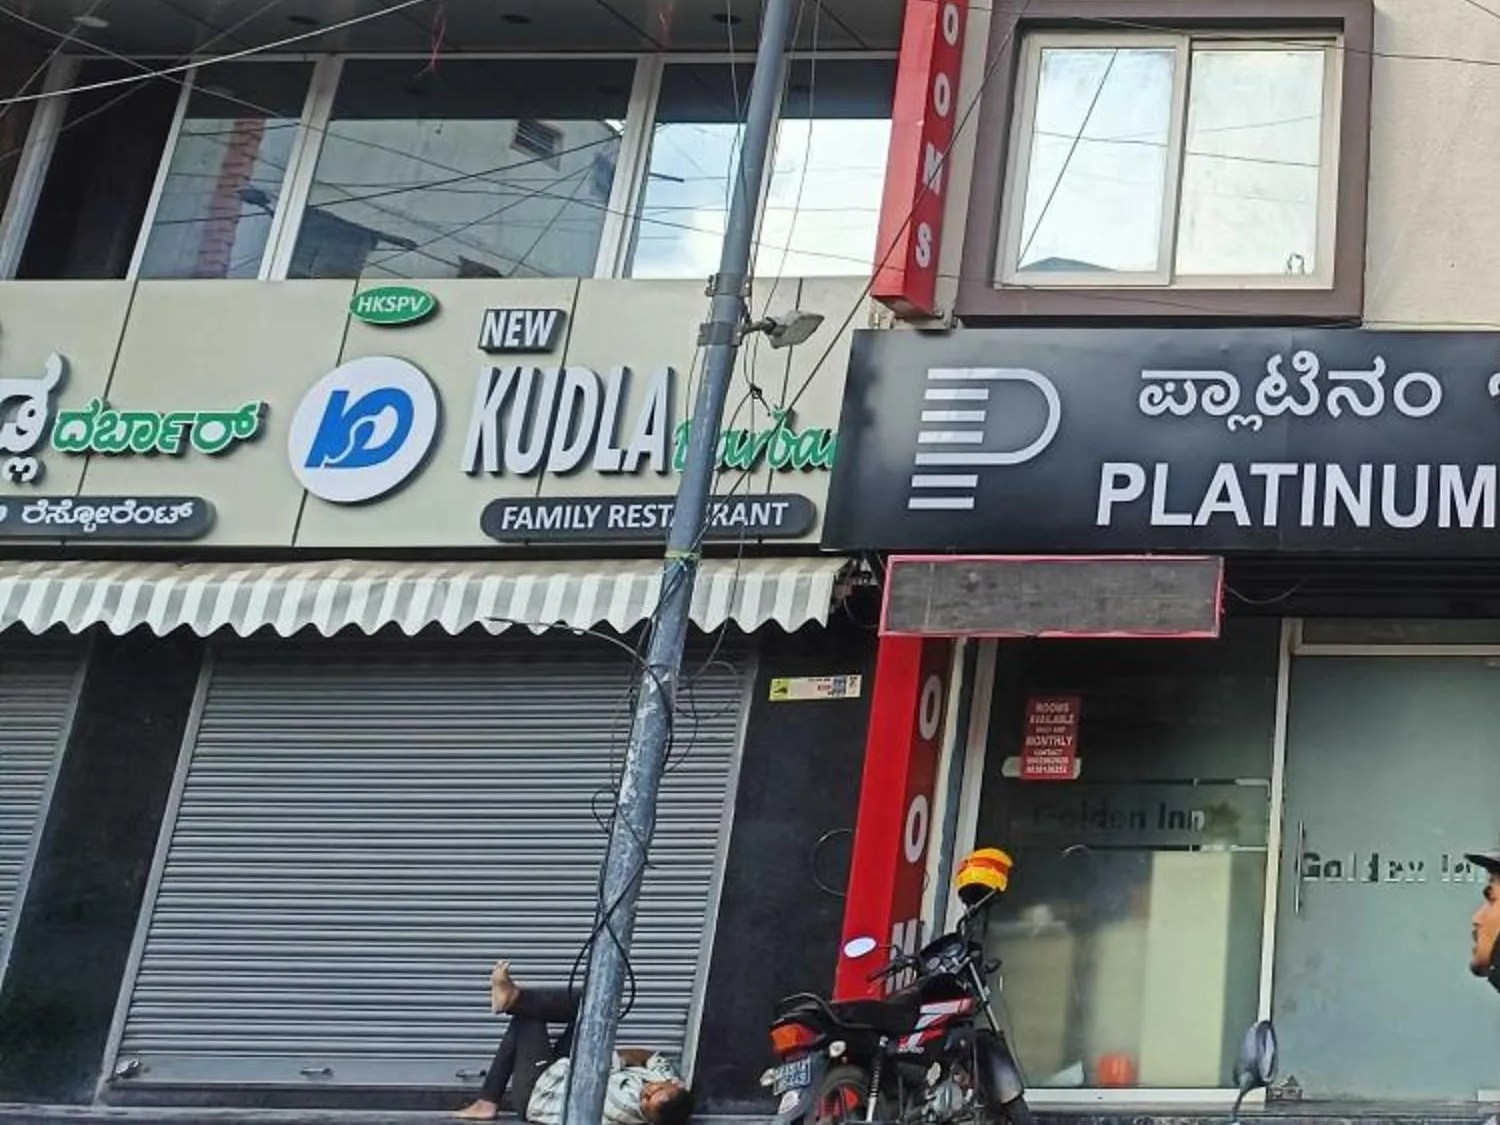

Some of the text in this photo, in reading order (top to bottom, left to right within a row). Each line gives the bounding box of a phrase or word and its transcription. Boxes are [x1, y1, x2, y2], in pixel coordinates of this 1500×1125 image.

[356, 295, 427, 313] HKSPV
[480, 310, 557, 348] NEW
[1137, 349, 1443, 431] ಪ್ಲಾಟಿನಂ
[462, 365, 674, 474] KUDLA
[500, 501, 789, 531] FAMILY RESTRANT
[1095, 460, 1499, 530] PLATINUM
